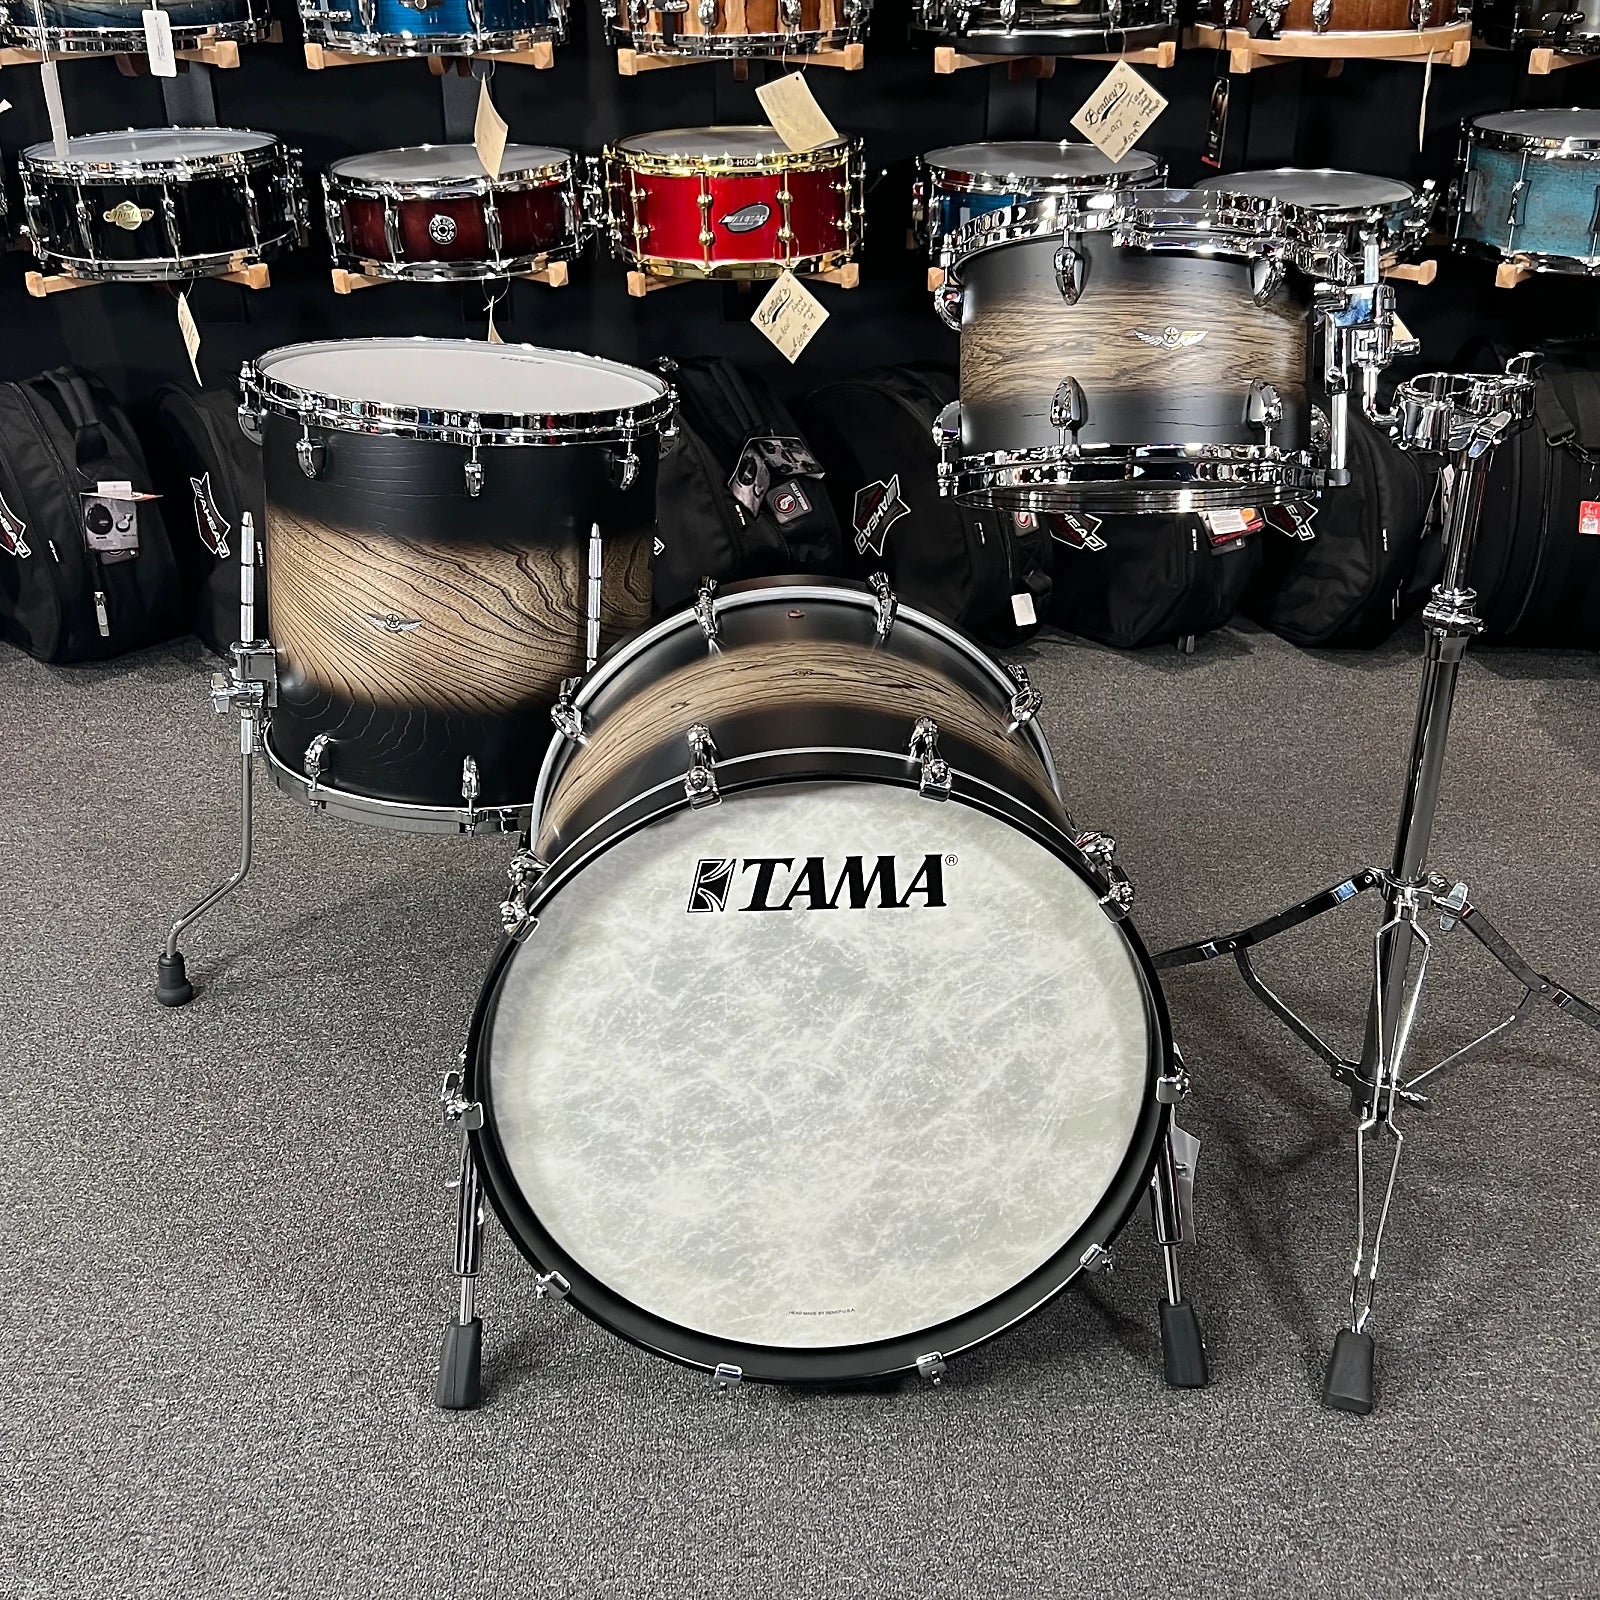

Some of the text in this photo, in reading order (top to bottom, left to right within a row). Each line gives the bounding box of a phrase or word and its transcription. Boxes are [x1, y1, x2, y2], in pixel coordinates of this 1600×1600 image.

[1085, 82, 1127, 128] Bentley's
[199, 499, 229, 554] AHEAD
[858, 495, 889, 548] AHEAD
[738, 854, 947, 911] TAMA
